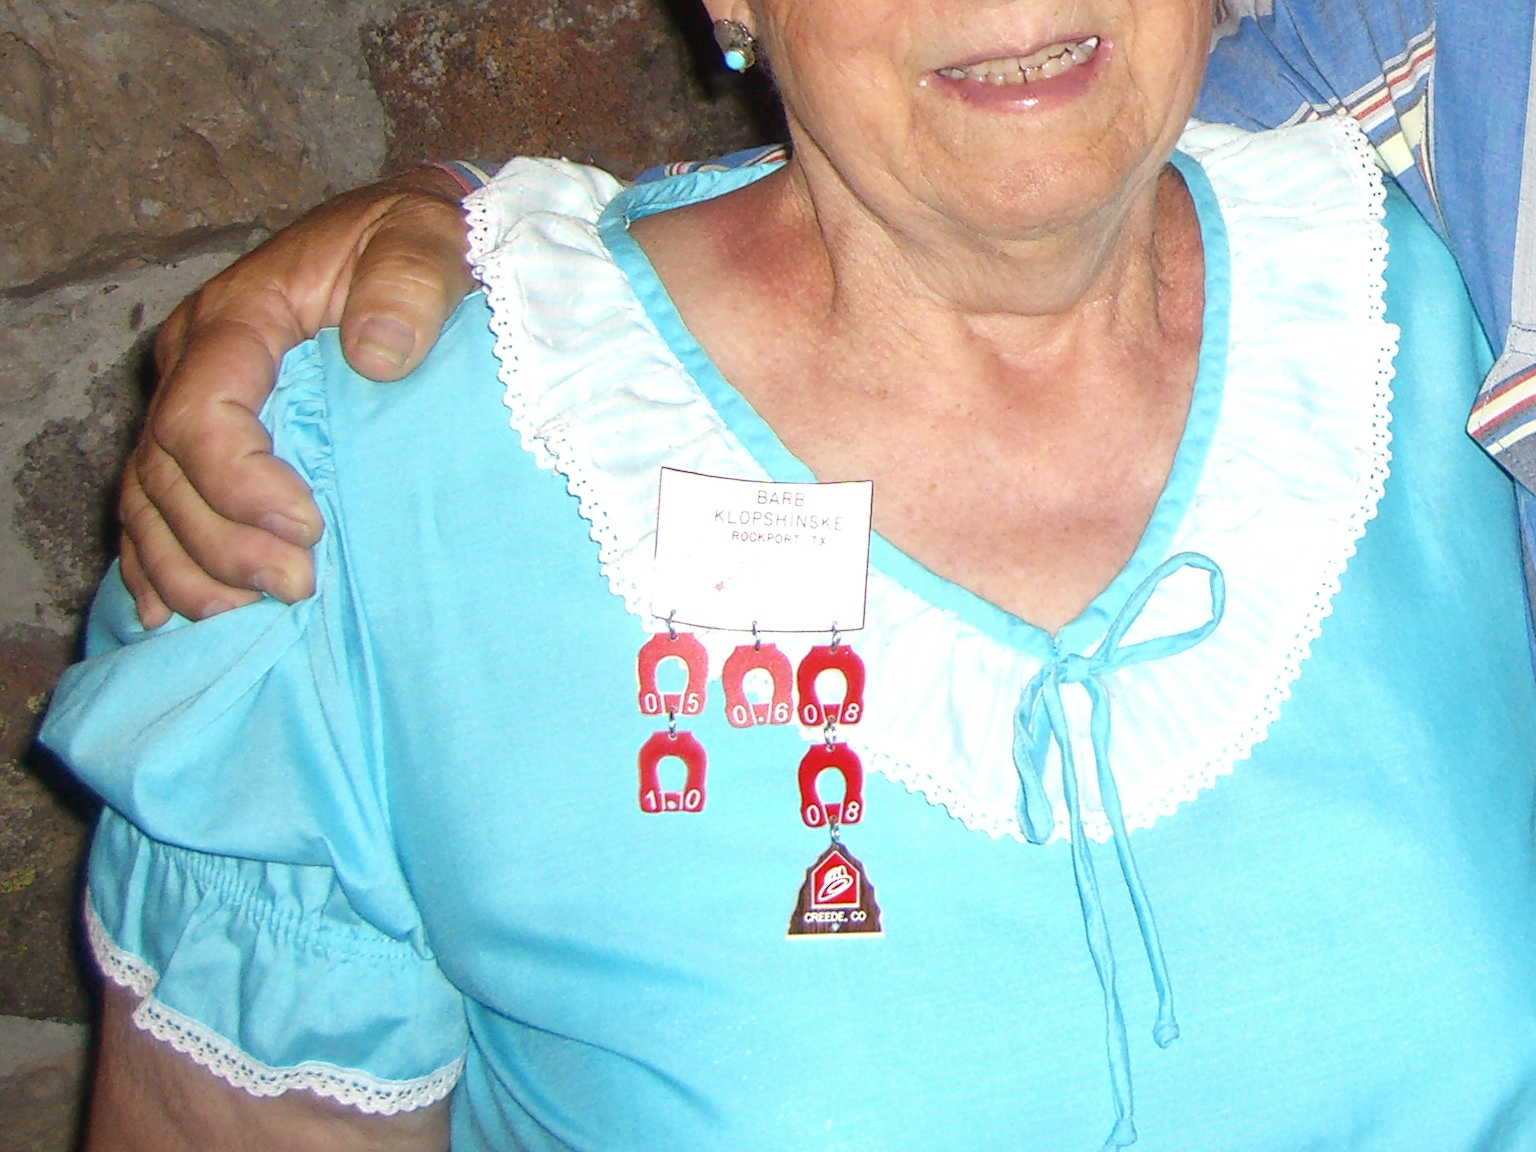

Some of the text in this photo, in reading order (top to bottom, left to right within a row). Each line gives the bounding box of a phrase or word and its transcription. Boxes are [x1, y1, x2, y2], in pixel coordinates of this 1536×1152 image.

[757, 490, 806, 507] BARB
[714, 510, 844, 532] KLOPSHINSKE
[812, 535, 826, 546] TX
[850, 911, 867, 922] CO
